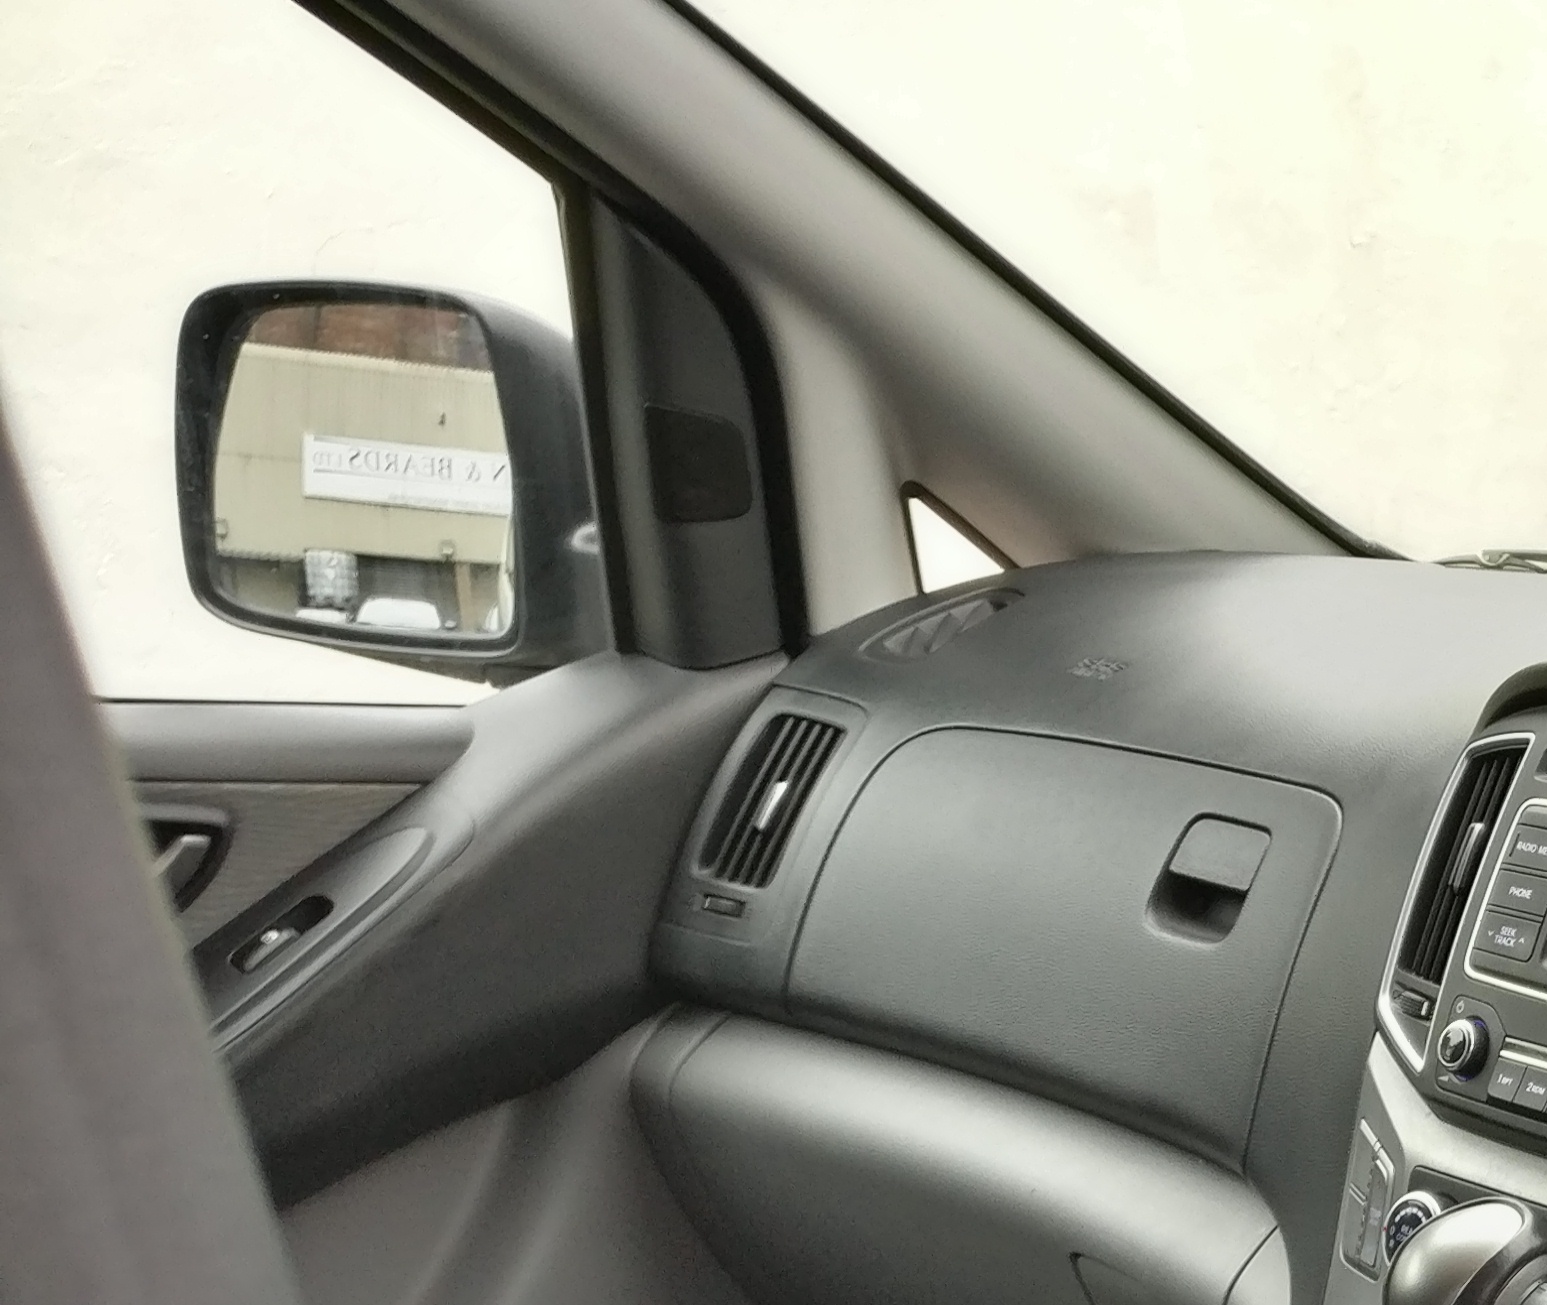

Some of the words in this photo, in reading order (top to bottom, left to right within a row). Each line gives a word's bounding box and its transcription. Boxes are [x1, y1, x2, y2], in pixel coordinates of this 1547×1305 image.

[1516, 840, 1538, 855] RADIO
[1508, 886, 1533, 900] PHONE
[1500, 925, 1518, 938] SEEK
[1493, 934, 1517, 948] TRACK
